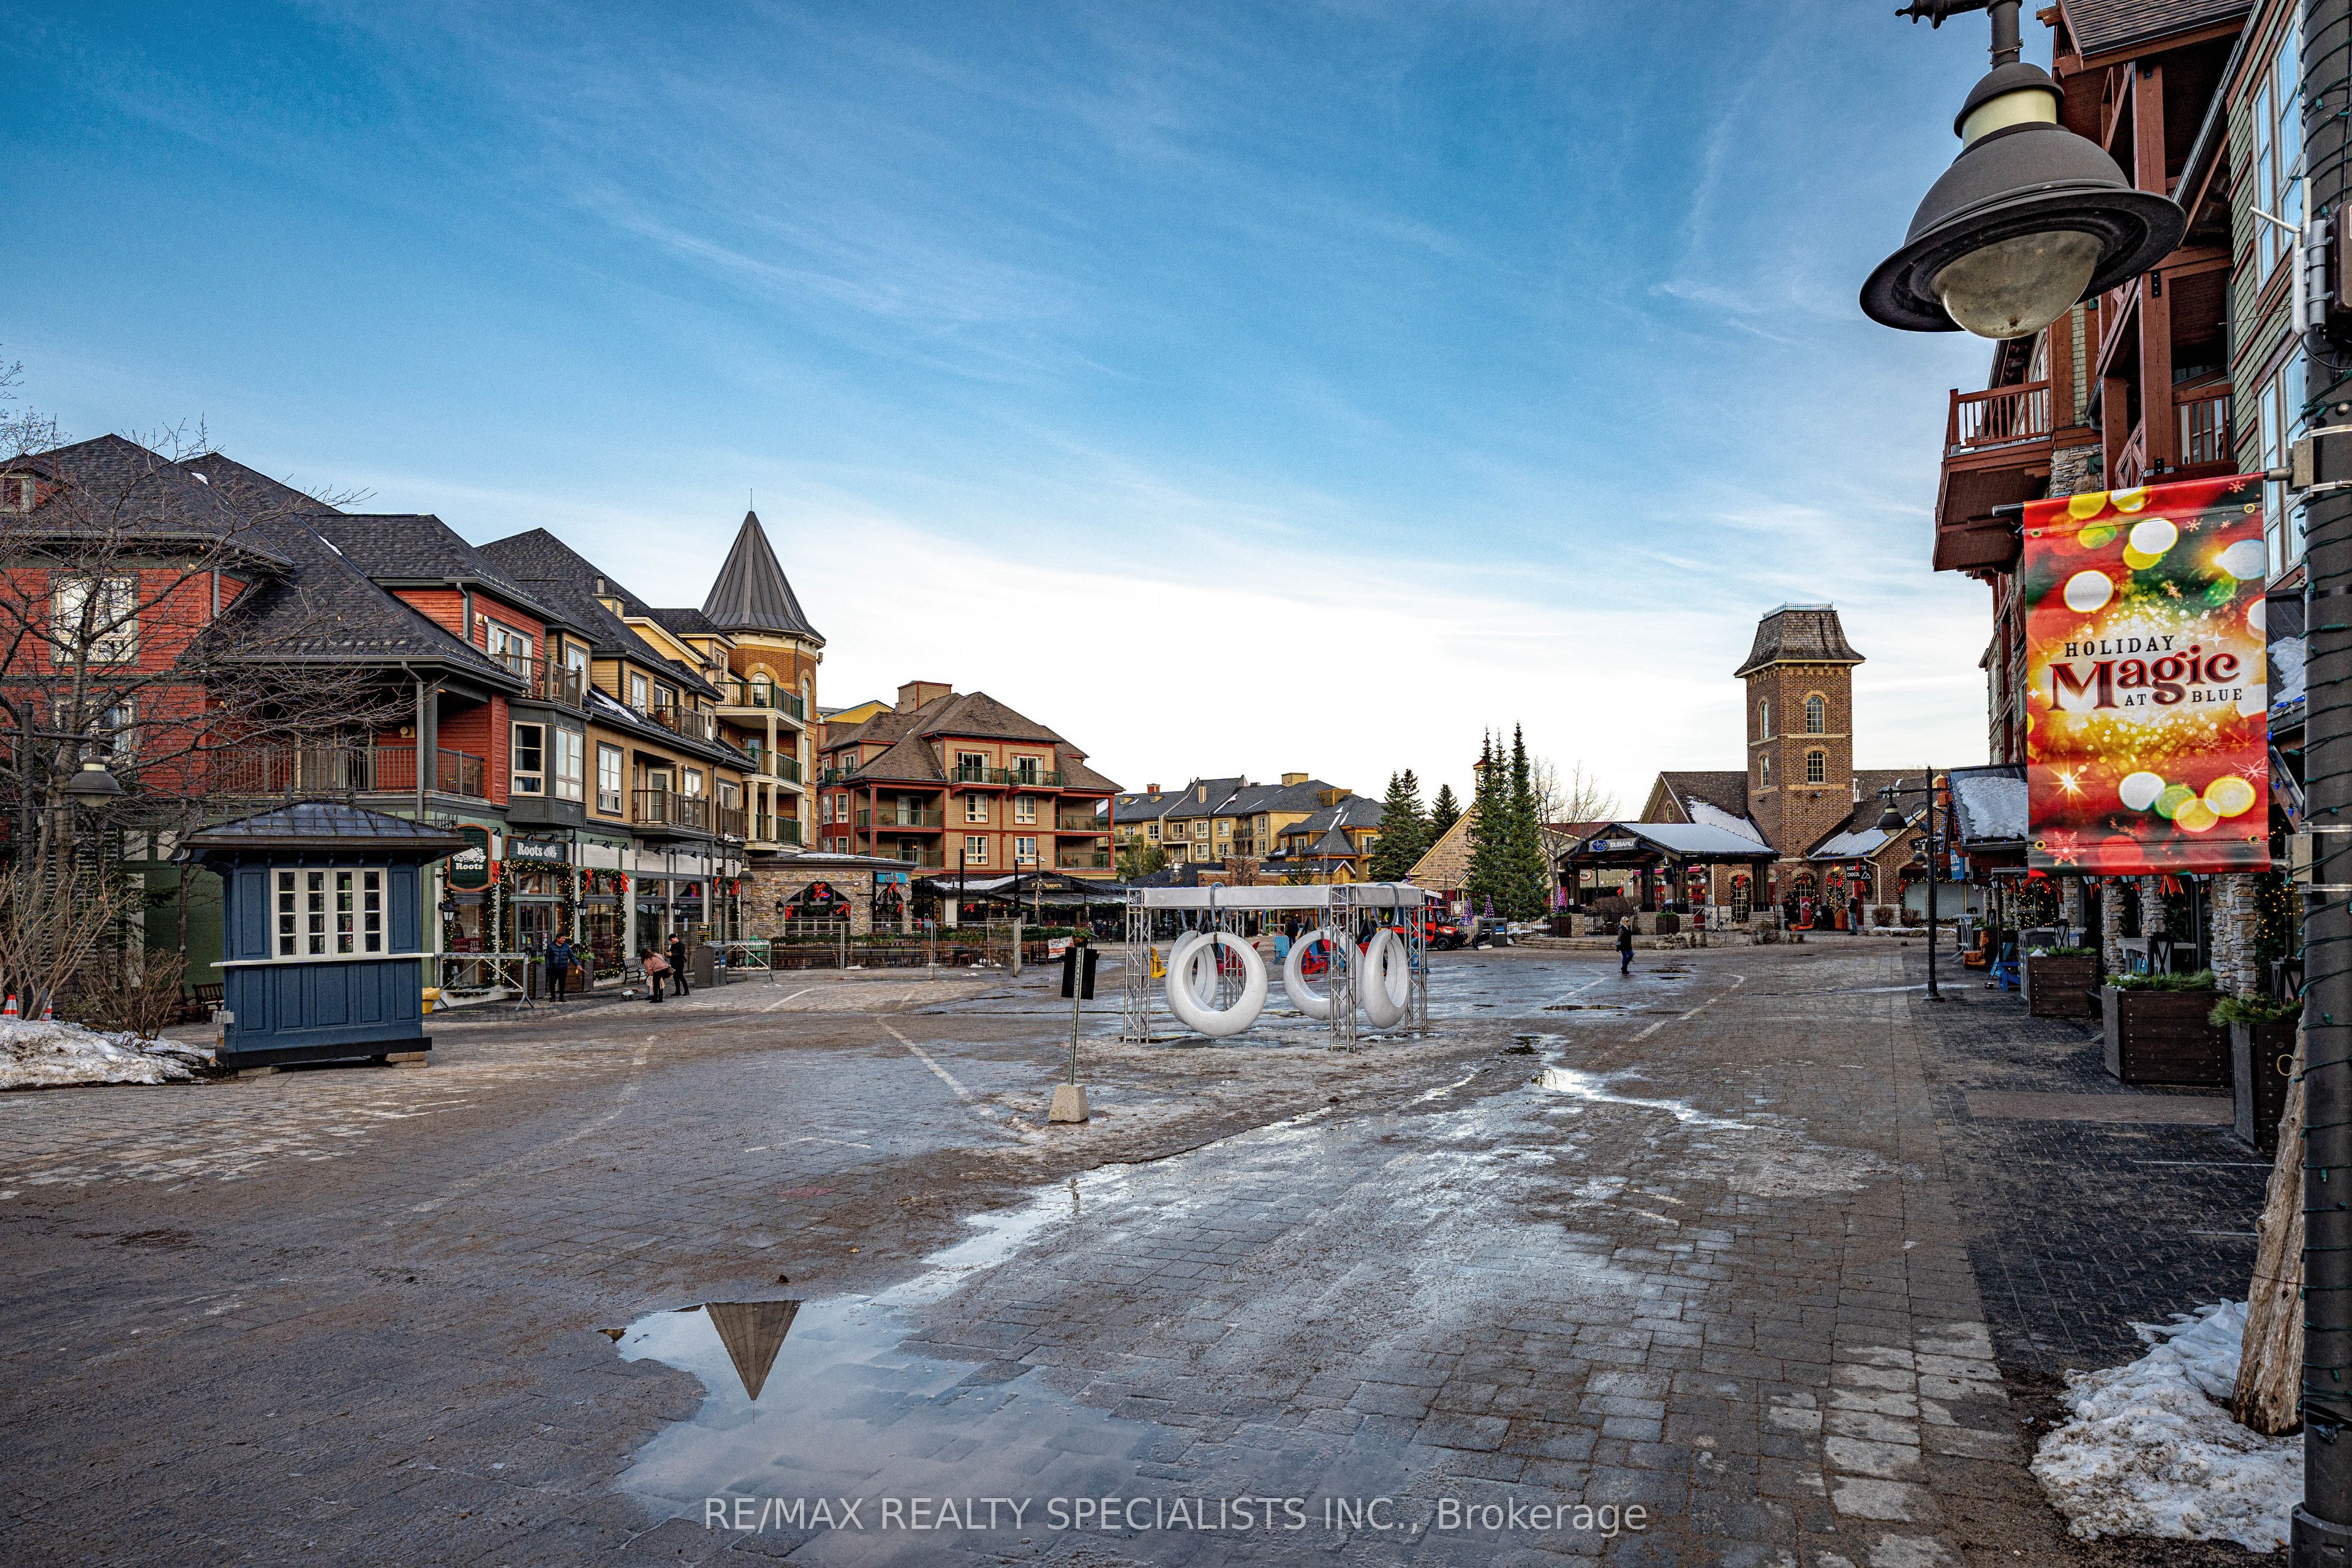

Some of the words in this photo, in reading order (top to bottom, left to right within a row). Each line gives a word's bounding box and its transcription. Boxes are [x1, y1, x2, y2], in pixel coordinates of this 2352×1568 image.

[2064, 635, 2174, 657] HOLIDAY
[2047, 644, 2241, 711] Magic
[2124, 693, 2147, 706] AT
[2192, 688, 2242, 703] BLUE
[517, 842, 543, 857] Roots
